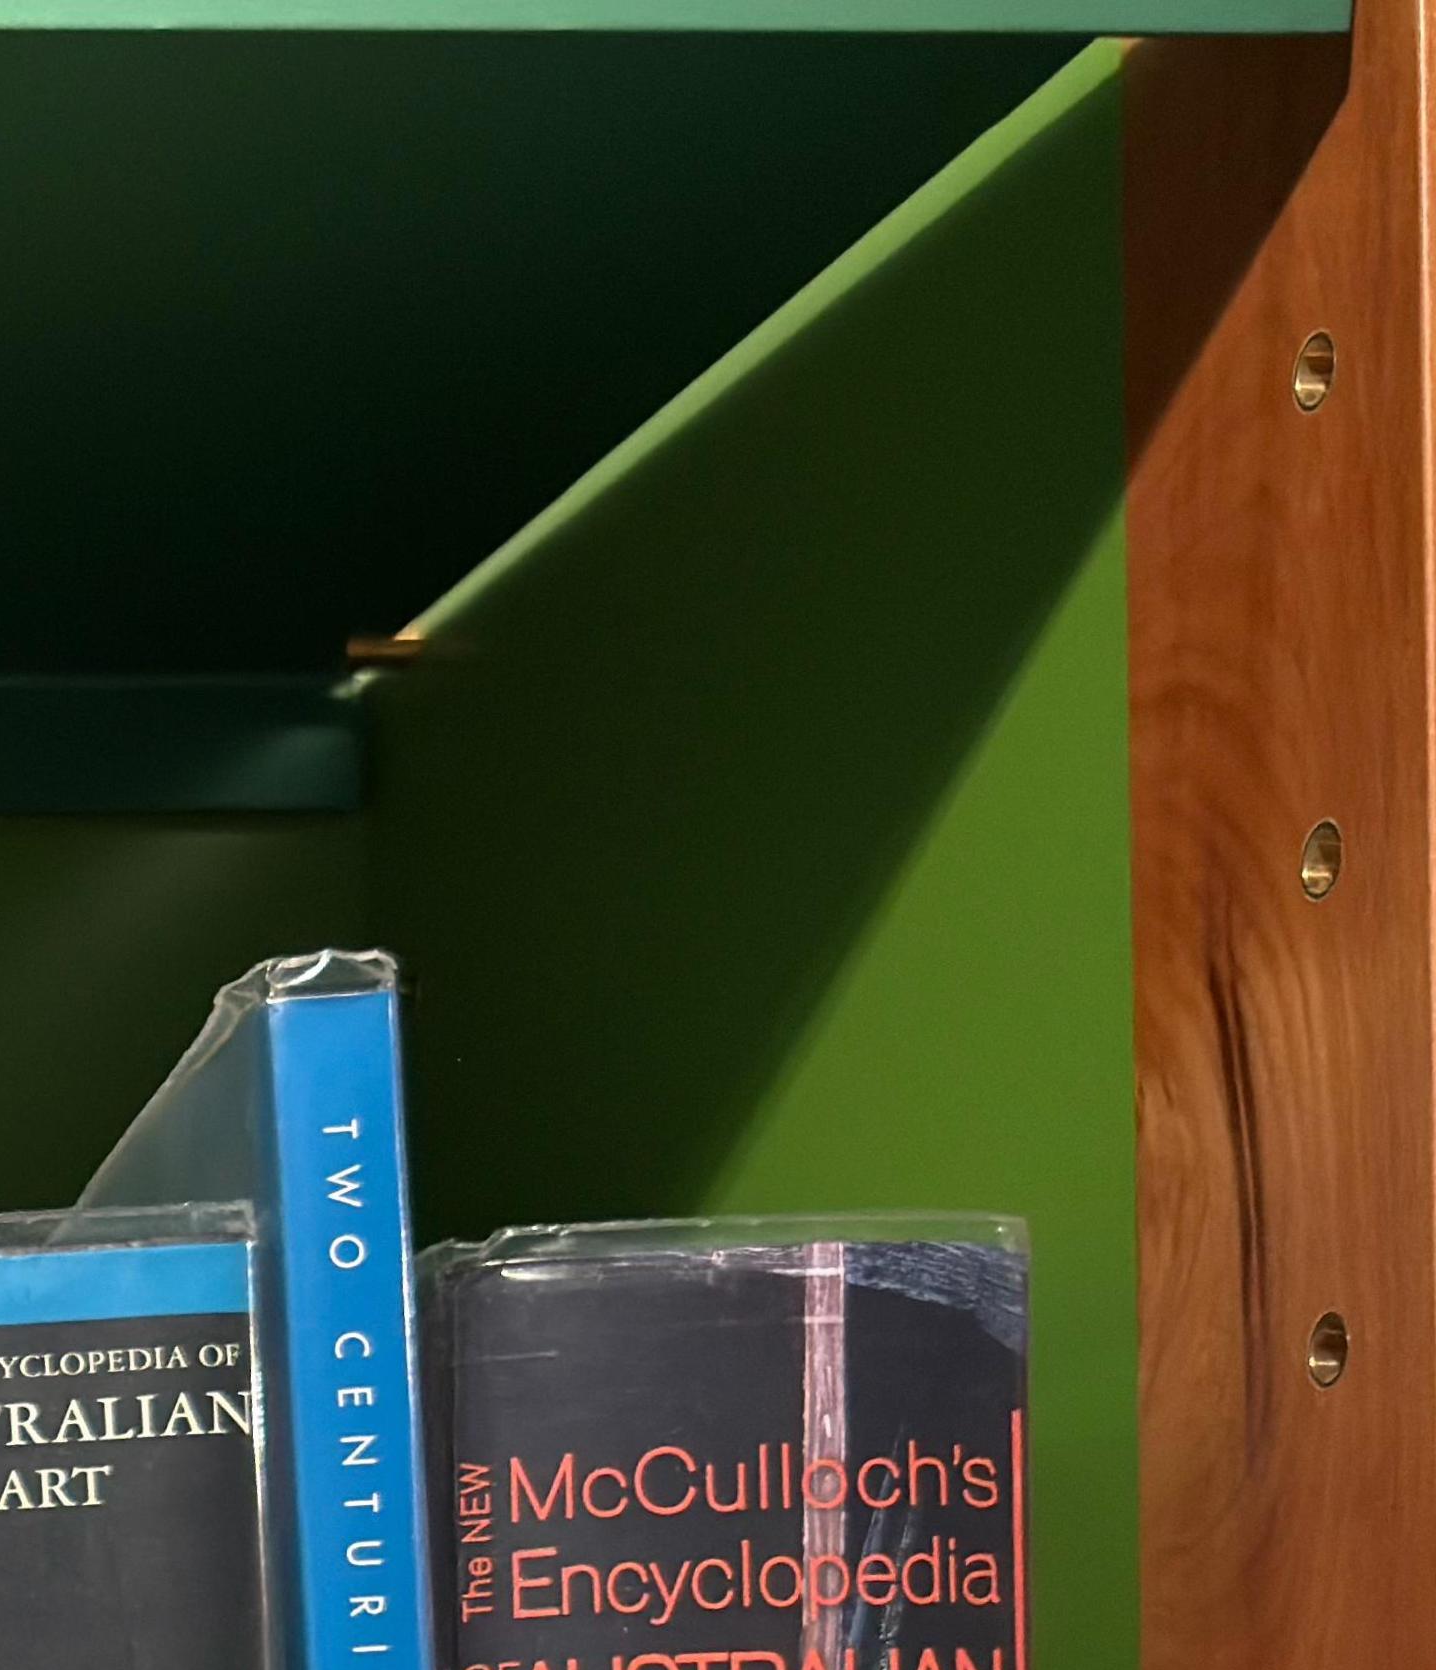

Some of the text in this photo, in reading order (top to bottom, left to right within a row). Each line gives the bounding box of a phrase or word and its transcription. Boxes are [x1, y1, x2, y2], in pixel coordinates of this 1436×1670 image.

[321, 1117, 368, 1269] TWO
[199, 1343, 241, 1370] OF
[460, 1463, 493, 1623] The NEW
[511, 1535, 1001, 1627] Encyclopedia
